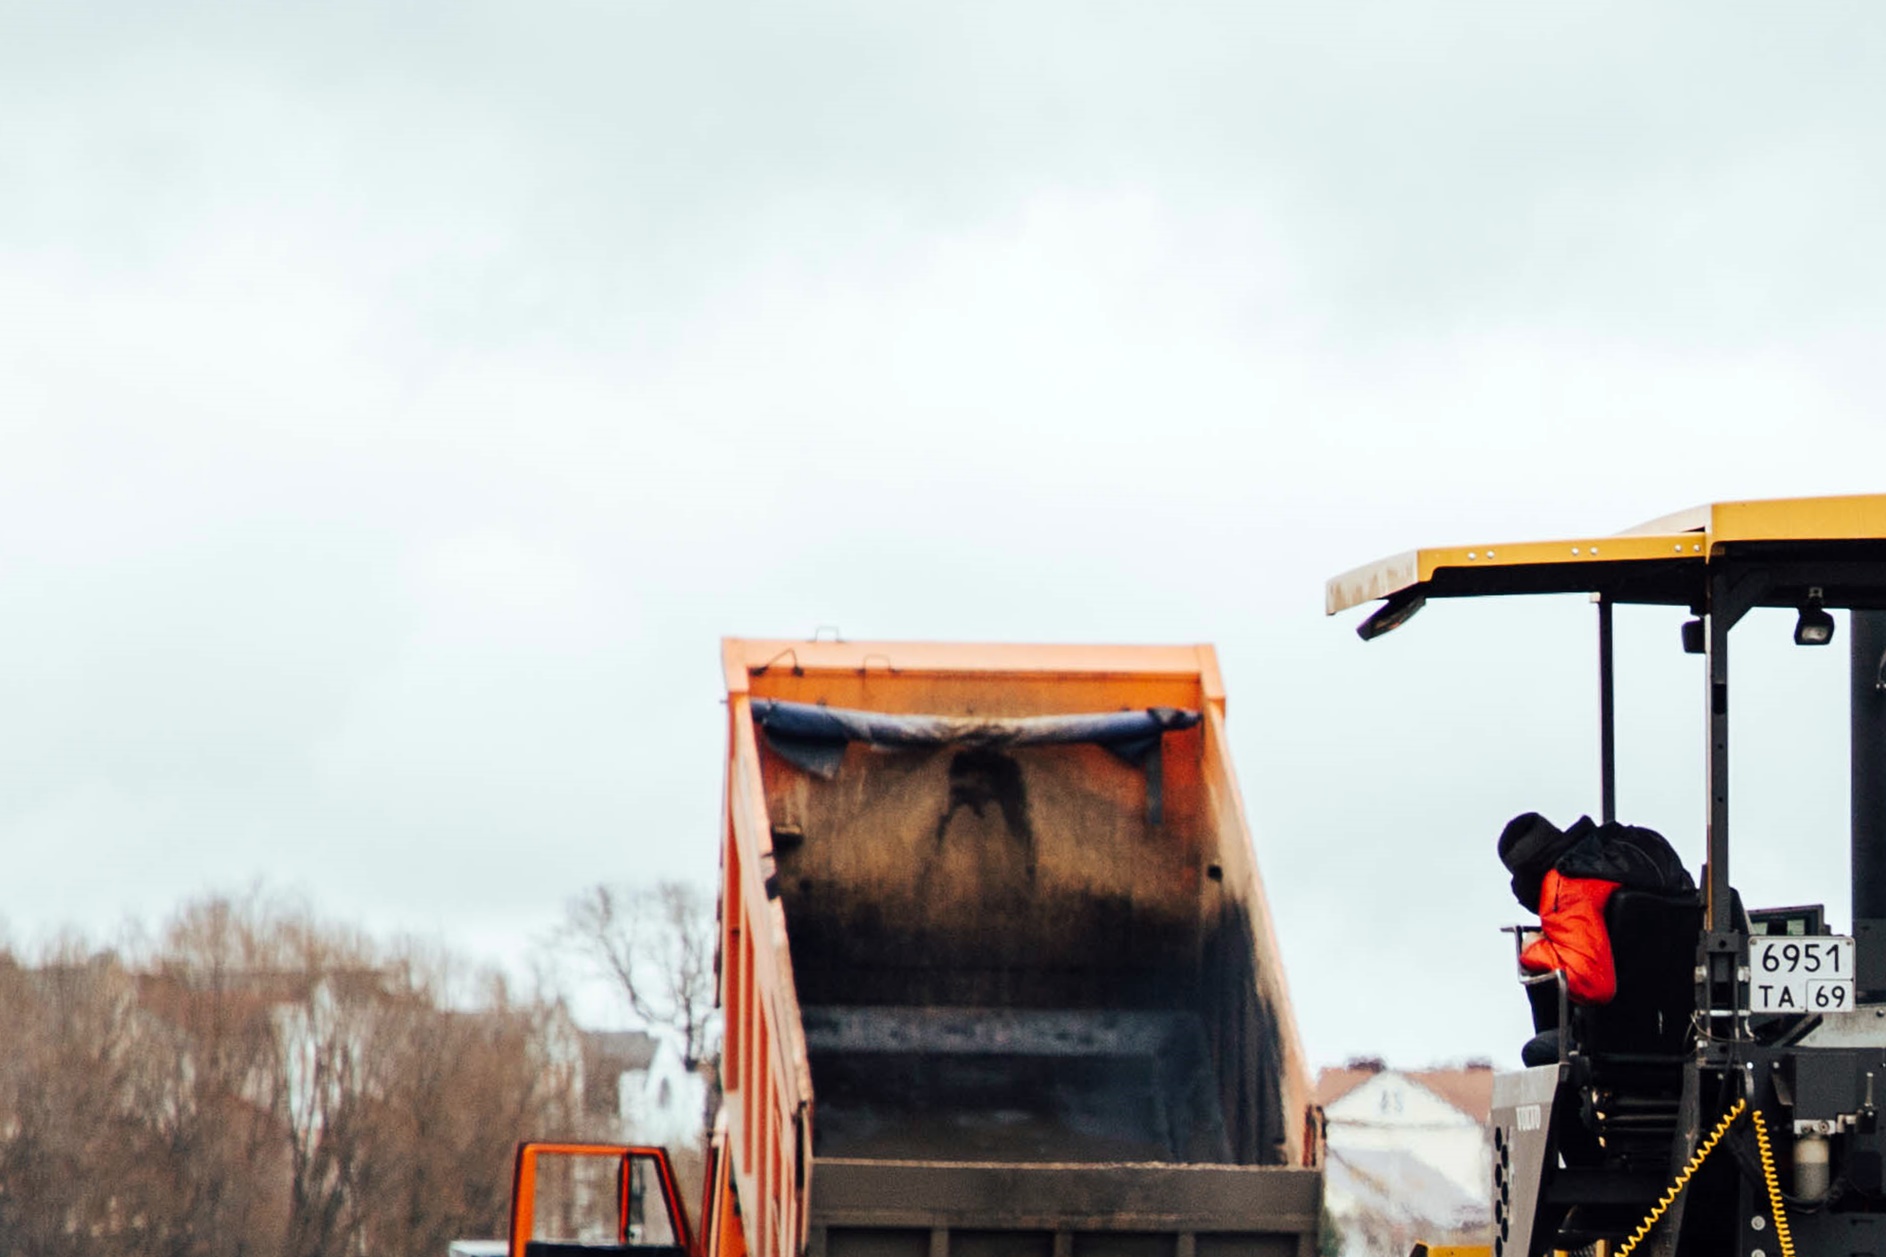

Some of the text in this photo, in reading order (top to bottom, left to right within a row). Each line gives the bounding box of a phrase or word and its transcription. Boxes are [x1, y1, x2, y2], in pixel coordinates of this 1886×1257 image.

[1762, 943, 1839, 973] 6951
[1758, 985, 1846, 1008] TA 69
